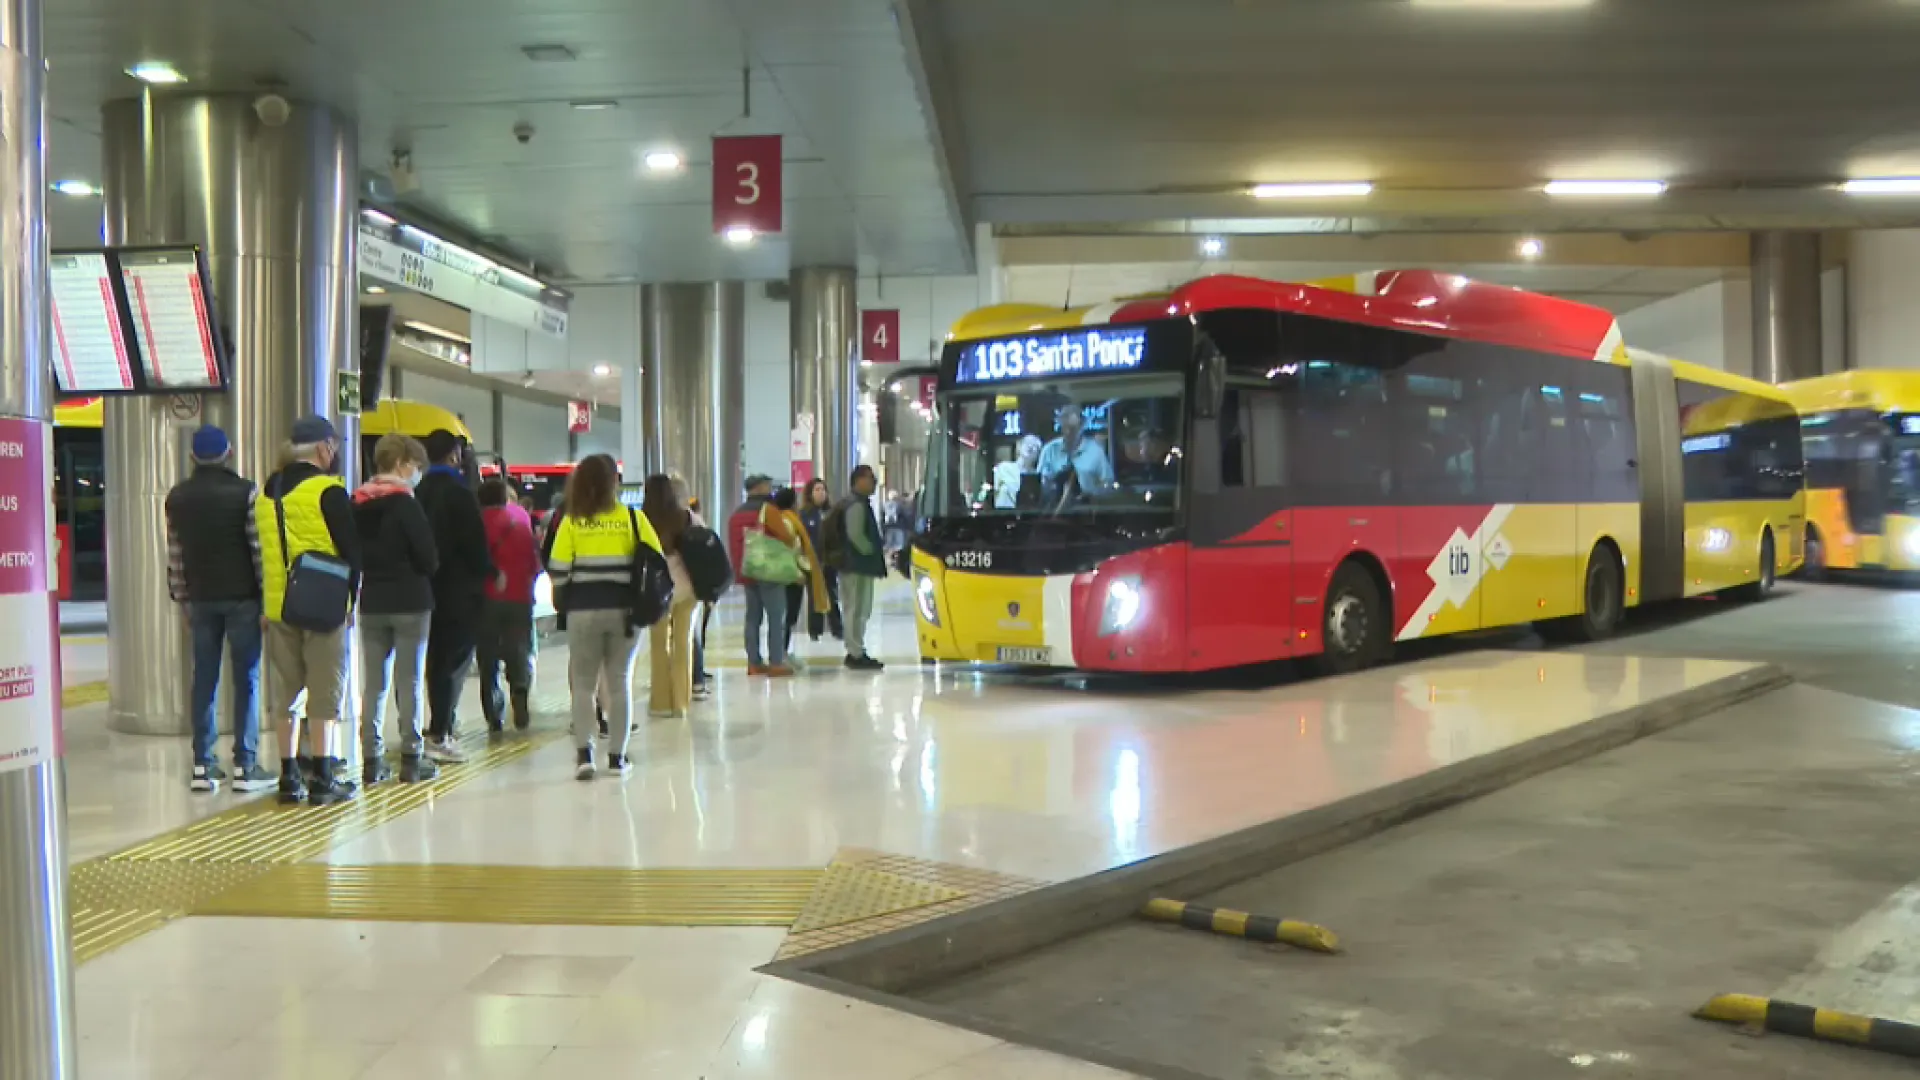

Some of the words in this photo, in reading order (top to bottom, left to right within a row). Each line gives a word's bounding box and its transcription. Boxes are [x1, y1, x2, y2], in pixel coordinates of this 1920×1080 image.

[735, 161, 760, 205] 3
[873, 323, 888, 349] 4
[974, 341, 1025, 380] 103
[1026, 336, 1083, 372] Santa
[955, 551, 992, 568] 13216
[1449, 545, 1468, 576] tib
